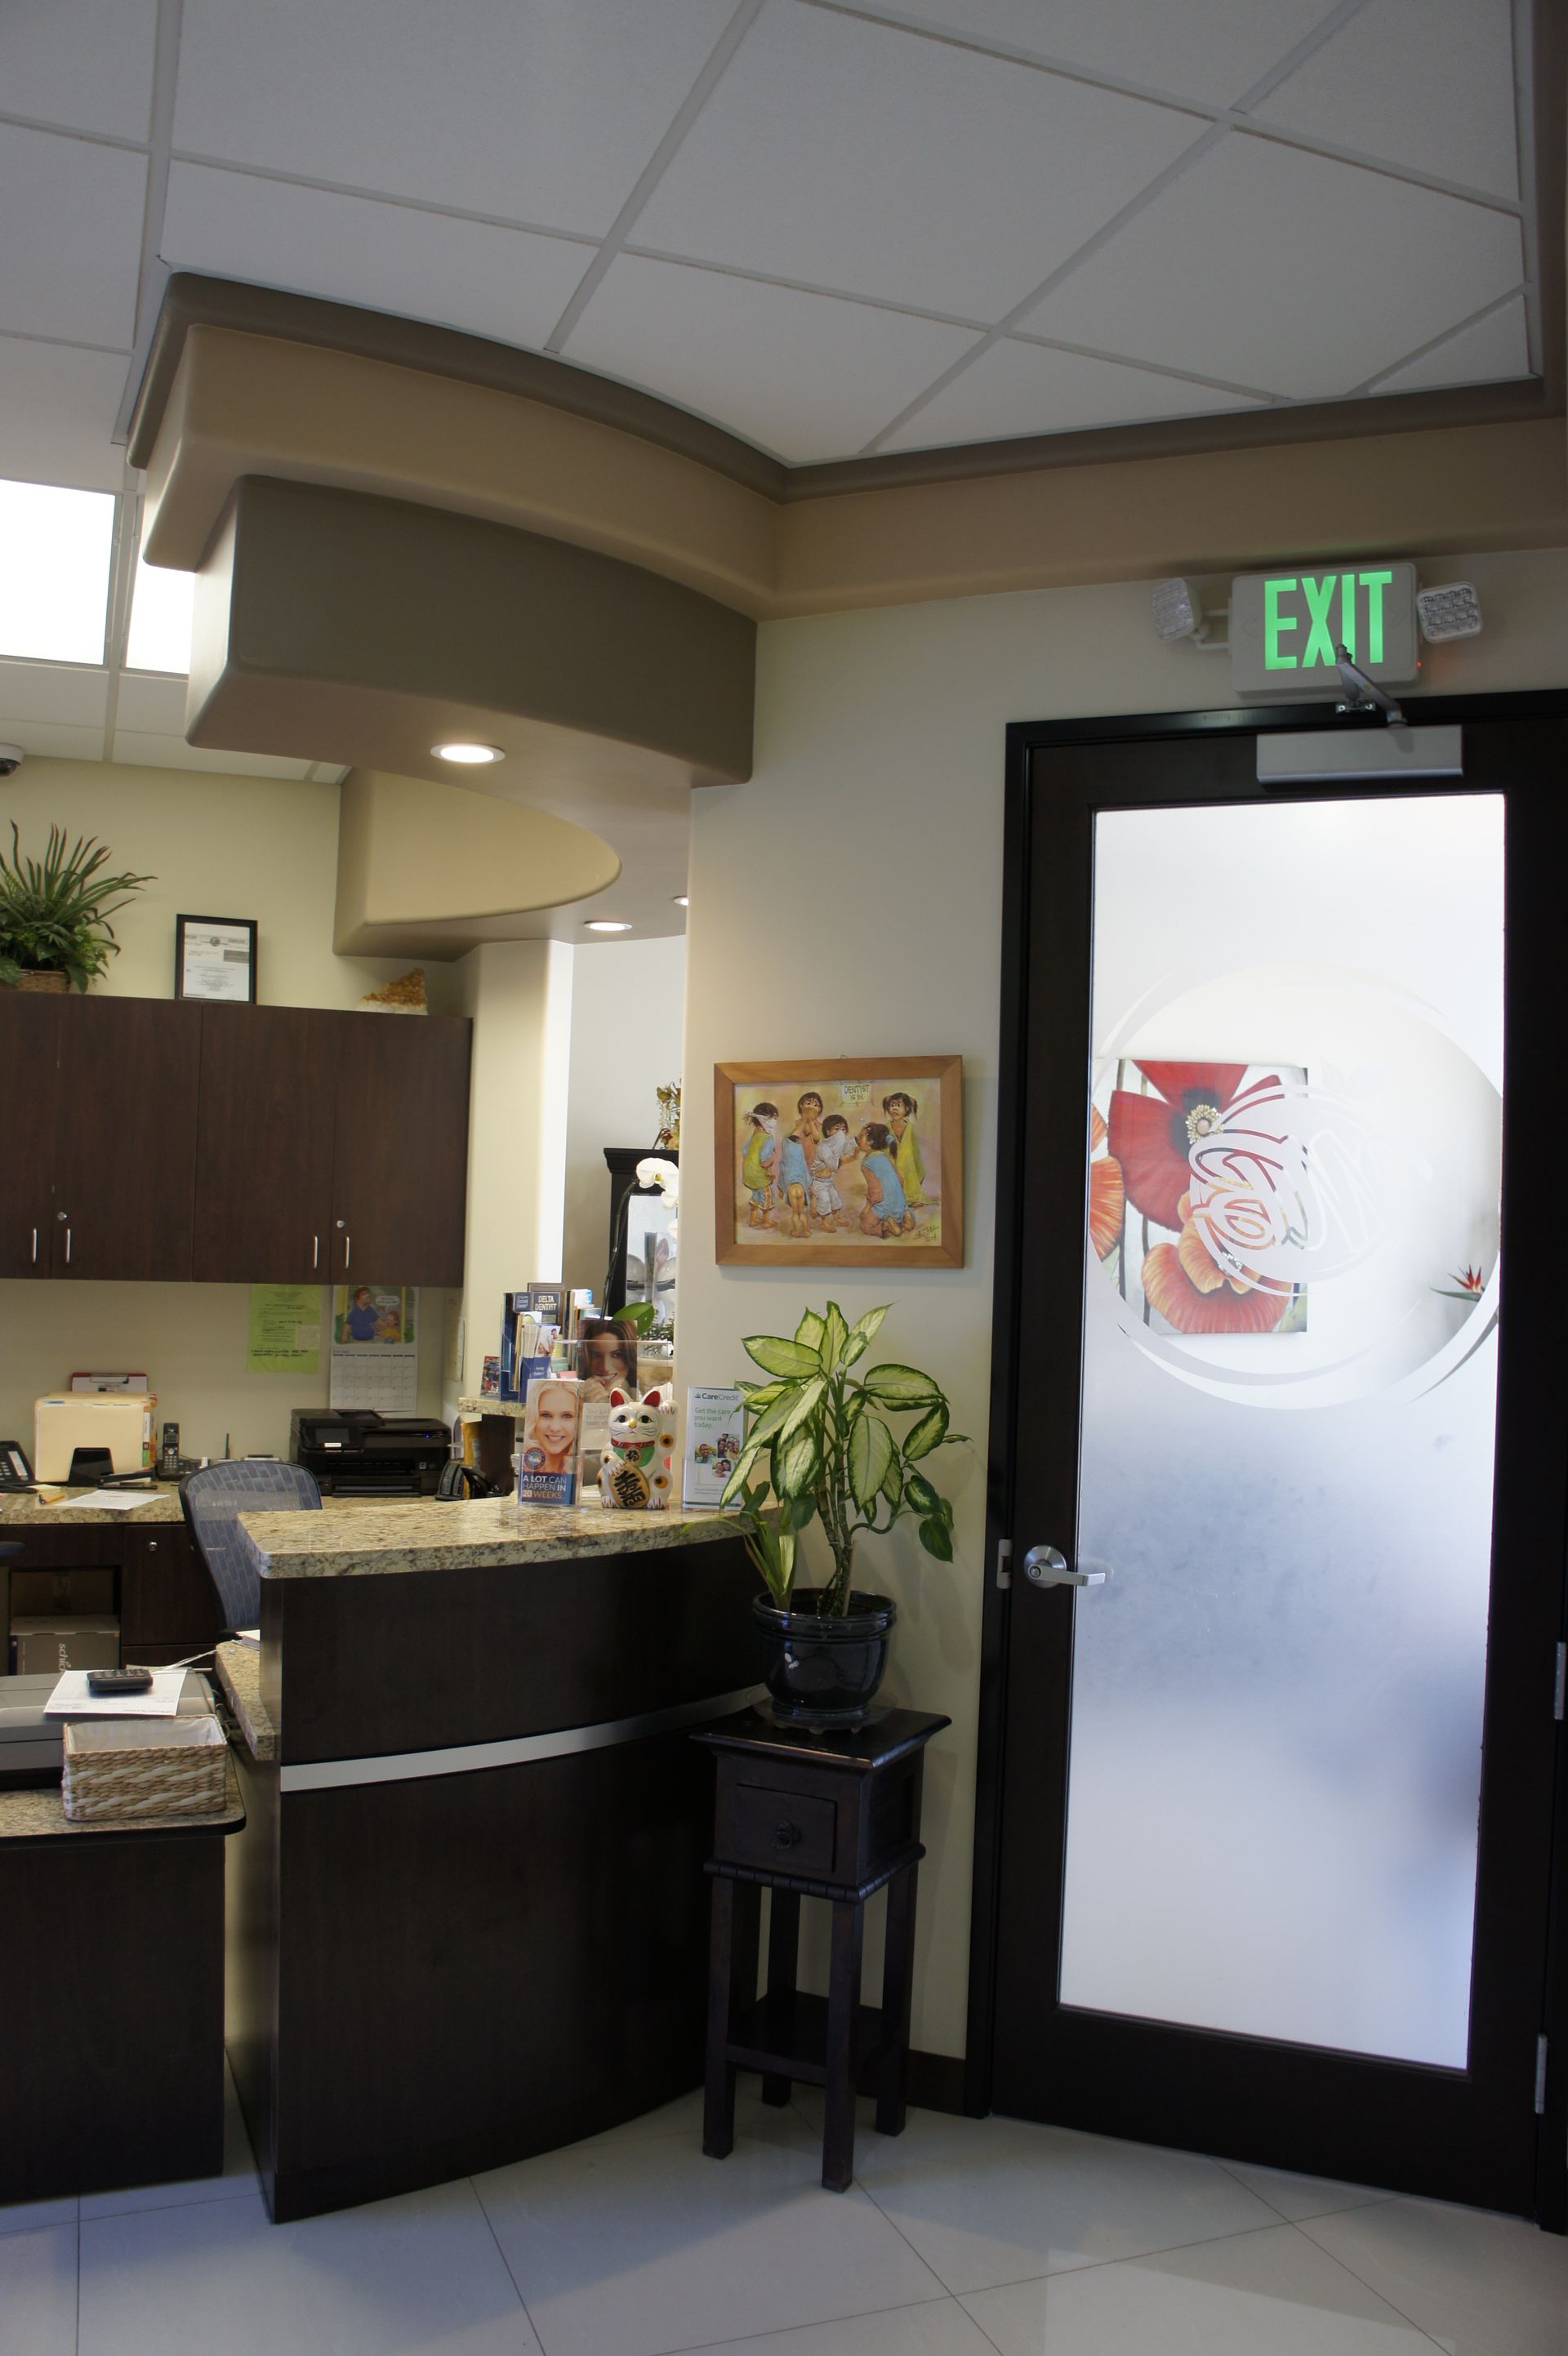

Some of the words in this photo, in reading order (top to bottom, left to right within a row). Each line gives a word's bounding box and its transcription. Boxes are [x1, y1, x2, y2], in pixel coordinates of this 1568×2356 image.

[1264, 571, 1392, 670] EXIT
[844, 1084, 870, 1094] DENTIST
[538, 1295, 555, 1303] DELTA
[702, 1392, 739, 1401] CareCredit
[523, 1490, 532, 1498] 20
